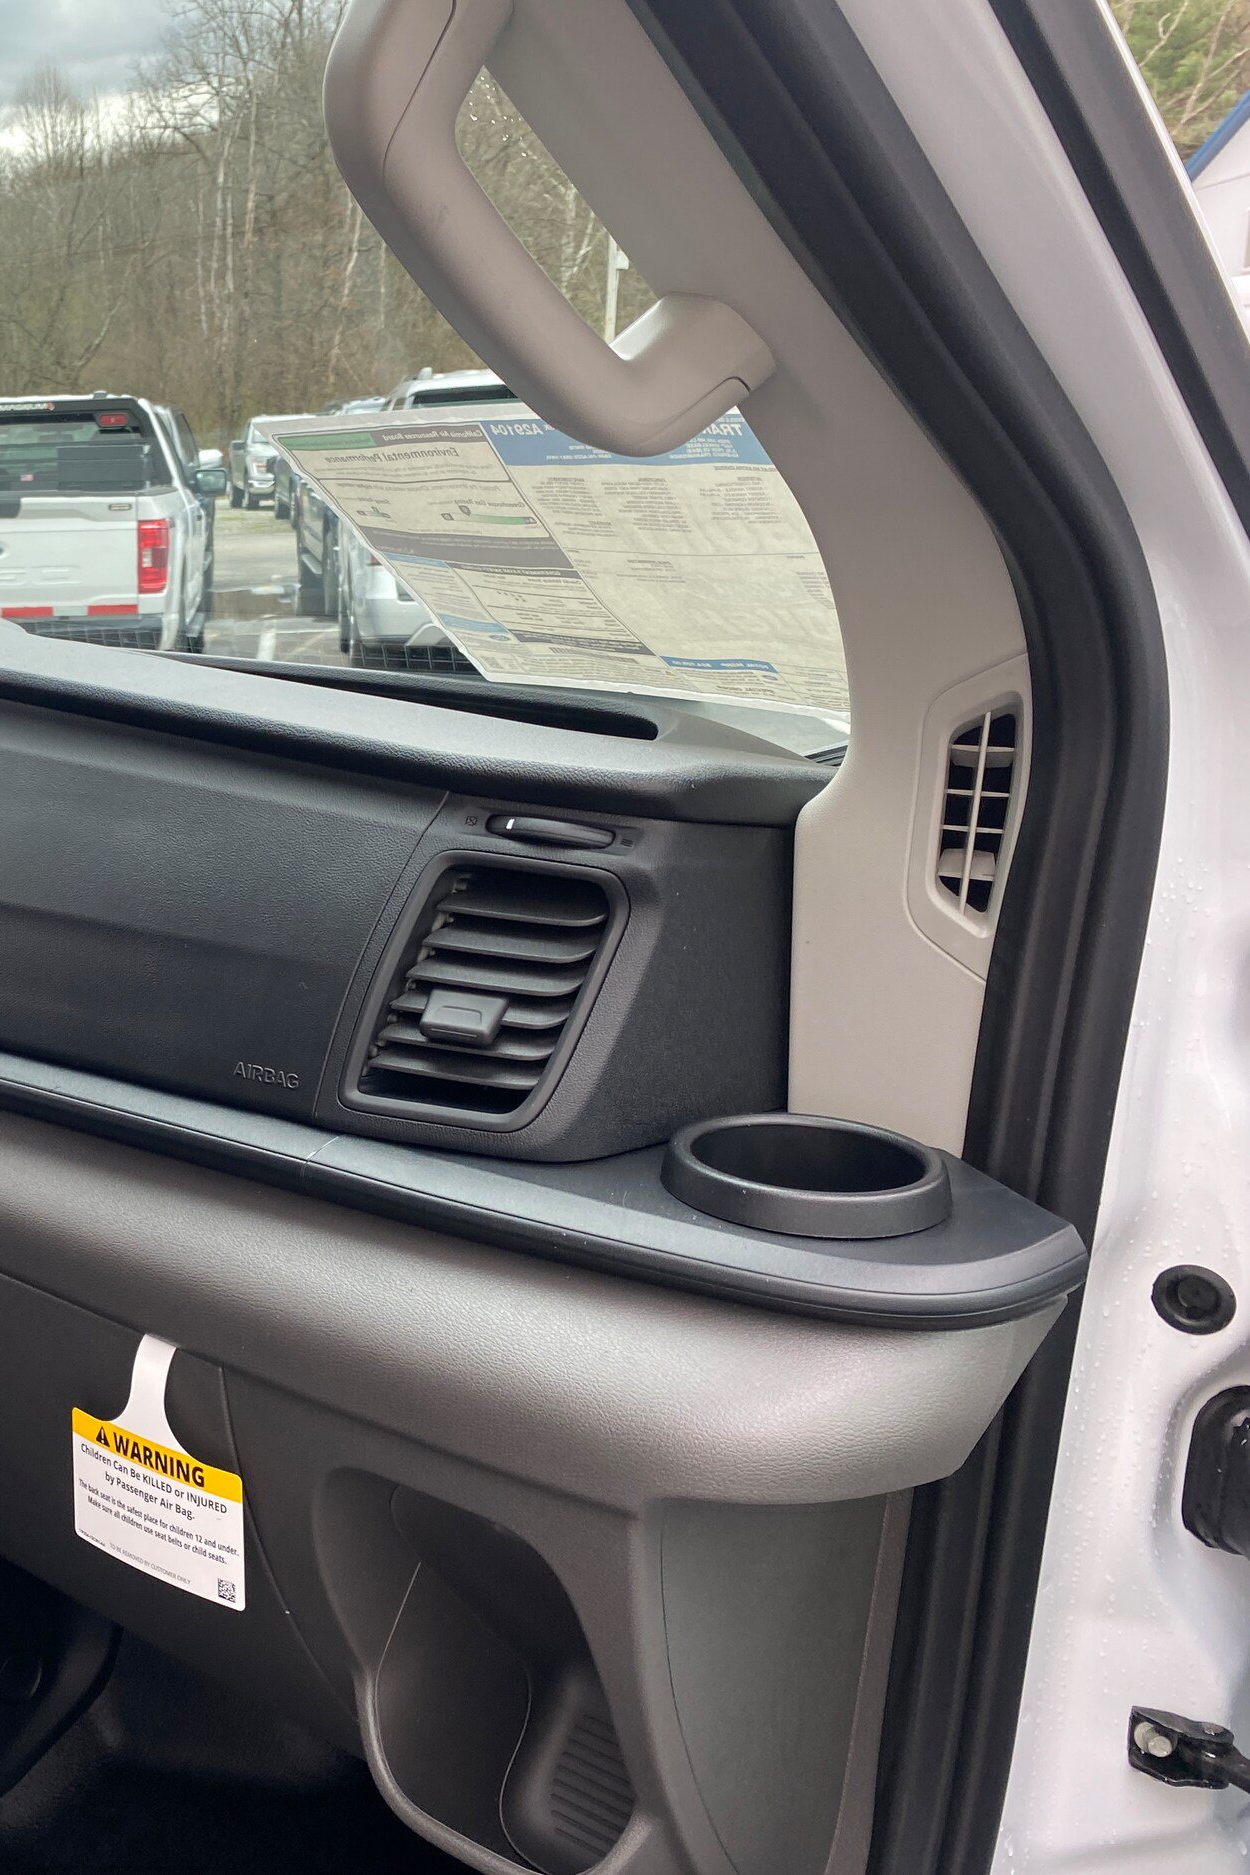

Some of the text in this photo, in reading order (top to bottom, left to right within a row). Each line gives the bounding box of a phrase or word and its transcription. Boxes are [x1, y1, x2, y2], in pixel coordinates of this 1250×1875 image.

[233, 1061, 299, 1089] AIRBAG
[81, 1443, 227, 1513] Children Can Be KILLED or INJURED
[113, 1432, 205, 1487] WARNING
[79, 1478, 239, 1557] The back seat is the safest place for children 12 and under.
[105, 1471, 195, 1520] by Passenger Air Bag.
[88, 1496, 101, 1509] Make
[102, 1505, 113, 1515] sure
[121, 1514, 142, 1529] children
[144, 1526, 153, 1535] use
[154, 1530, 166, 1541] seat
[168, 1535, 182, 1548] belts
[192, 1545, 207, 1557] child
[208, 1552, 227, 1565] seats.
[122, 1548, 143, 1564] REMOVED
[151, 1563, 177, 1580] CUSTOMER
[177, 1575, 191, 1585] ONLY
